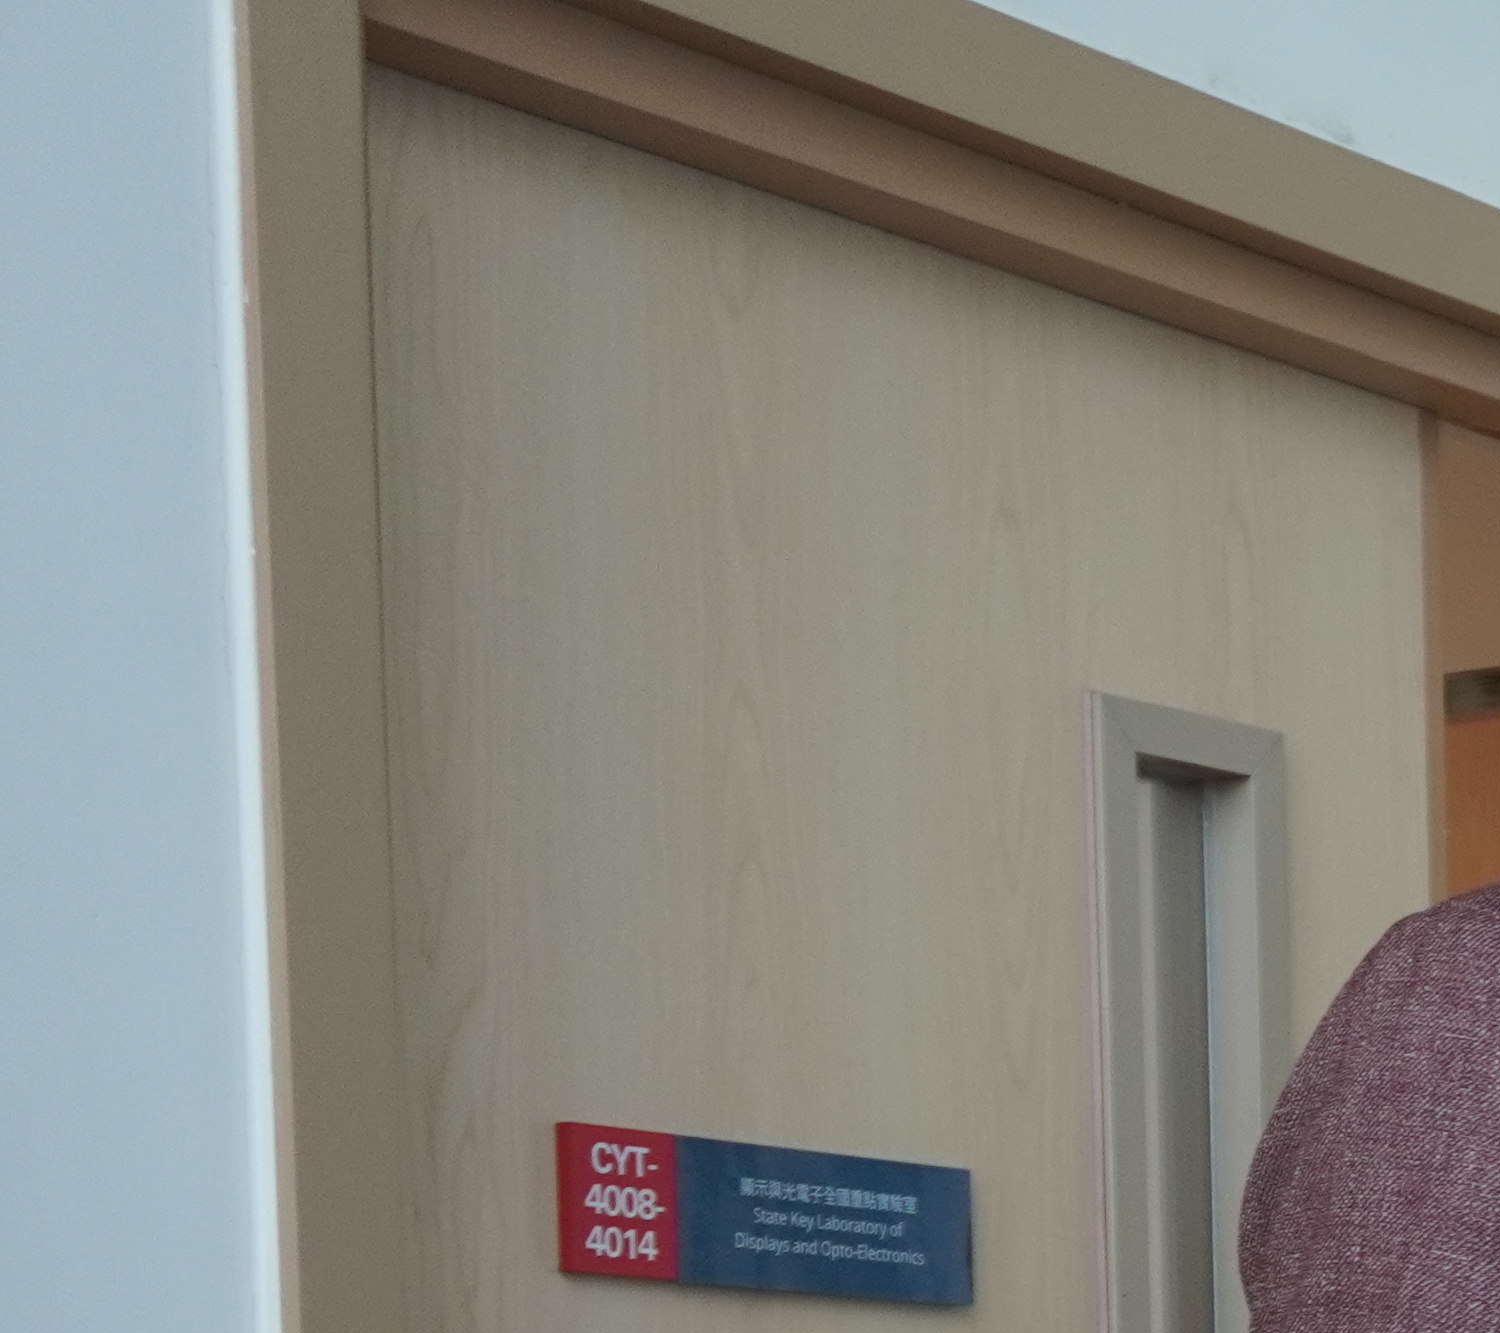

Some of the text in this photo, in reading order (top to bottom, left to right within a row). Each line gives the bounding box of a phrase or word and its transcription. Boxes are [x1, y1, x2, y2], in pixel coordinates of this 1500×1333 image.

[591, 1141, 659, 1178] CYT-
[584, 1183, 667, 1221] 4008-
[753, 1207, 904, 1240] State Key Laboratory of
[585, 1225, 659, 1261] 4014
[734, 1232, 925, 1266] Displays and Opto-Electronics
